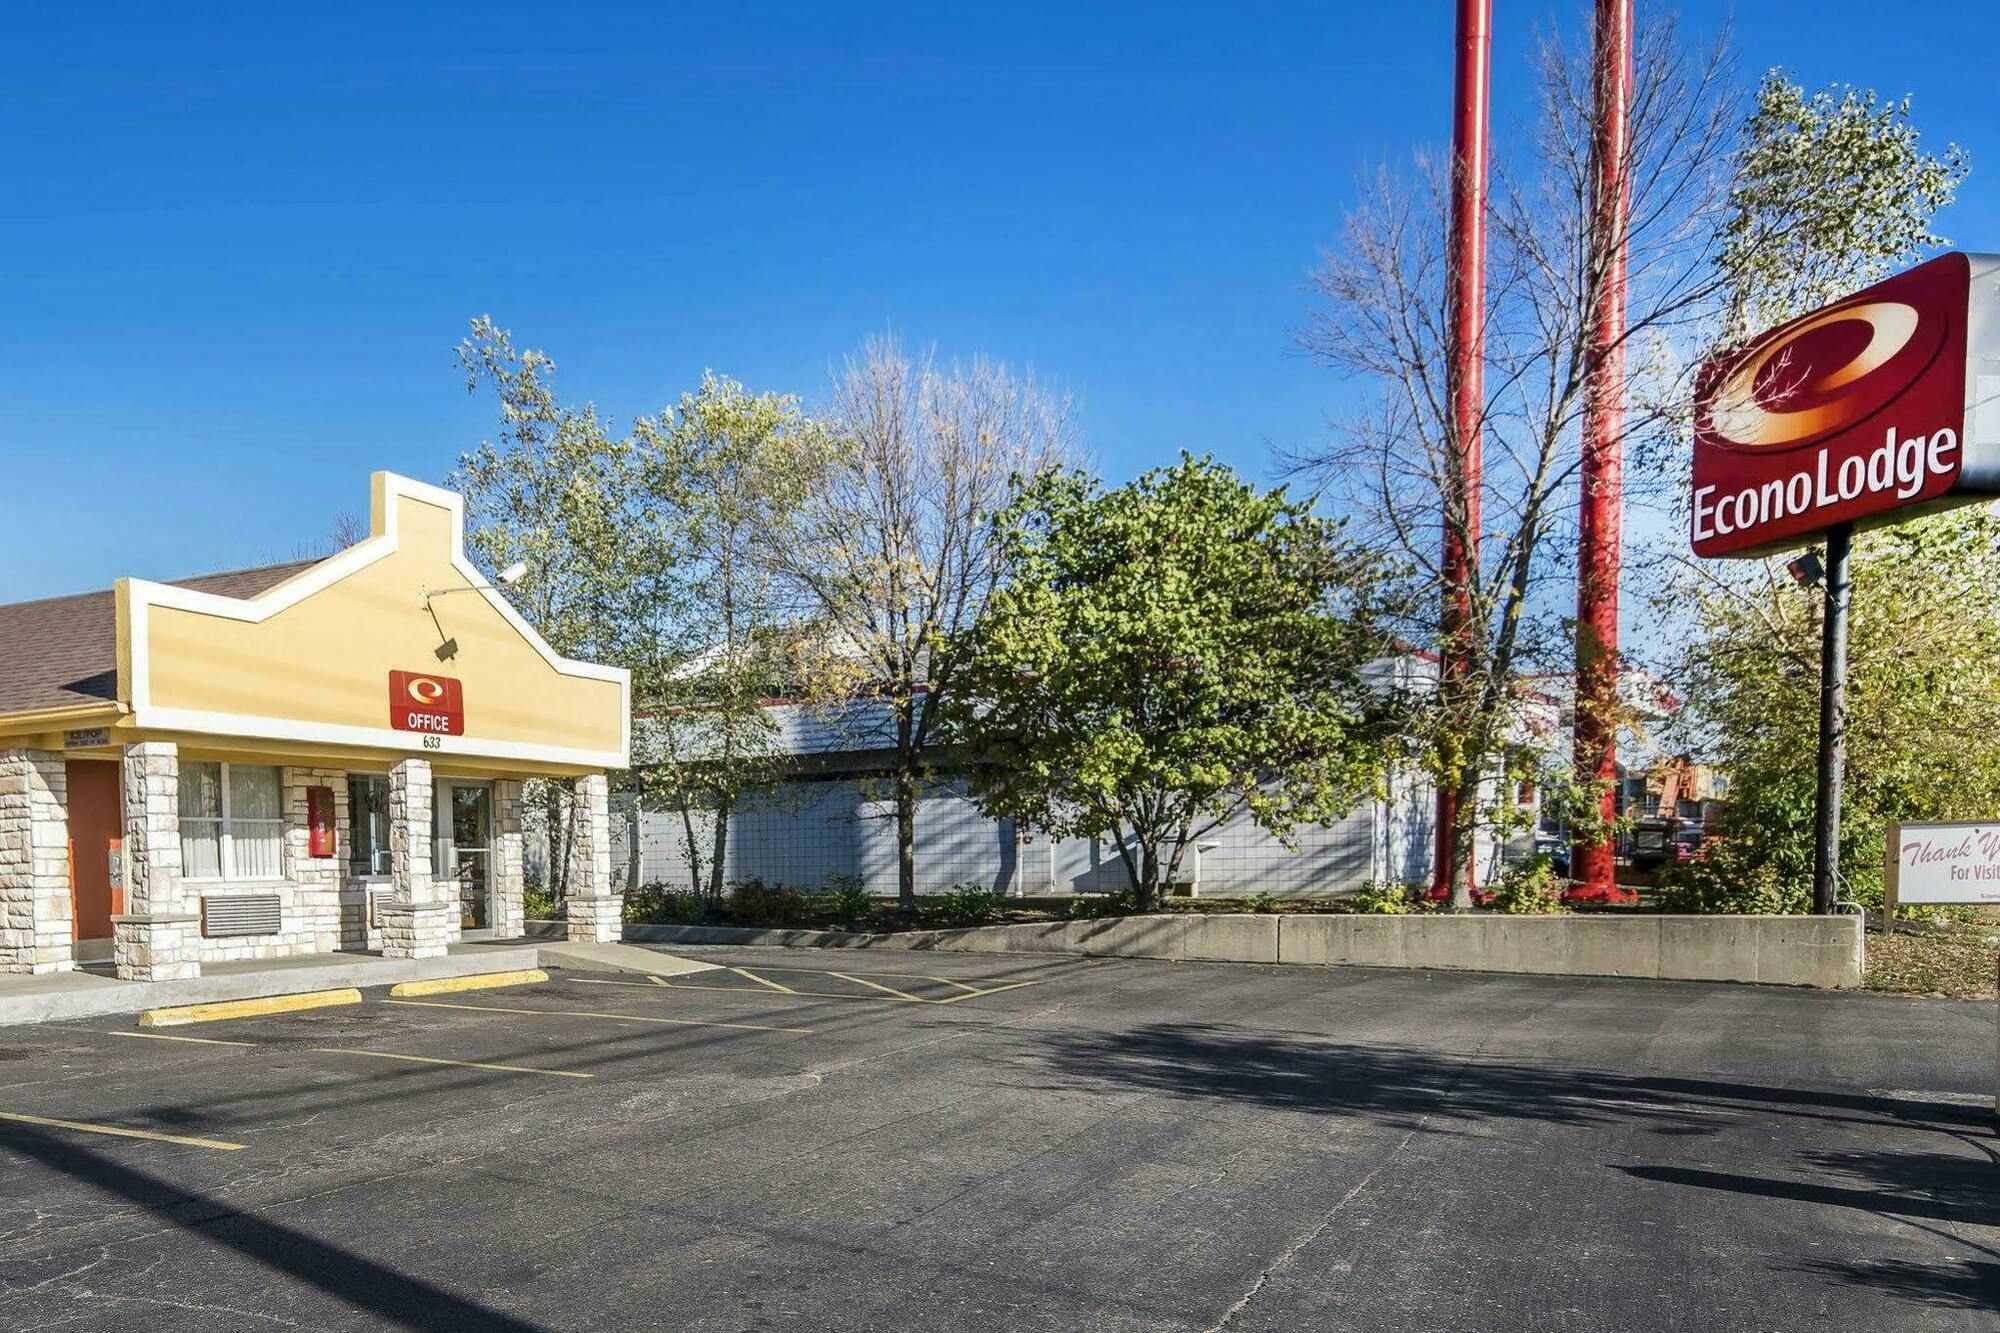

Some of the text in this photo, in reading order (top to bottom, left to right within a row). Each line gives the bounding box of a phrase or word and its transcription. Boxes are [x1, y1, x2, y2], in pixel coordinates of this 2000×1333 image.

[1693, 426, 1958, 542] EconoLodge
[408, 712, 449, 731] OFFICE
[423, 735, 441, 749] 633
[1902, 831, 2000, 866] Thank Y
[1951, 865, 1970, 880] For
